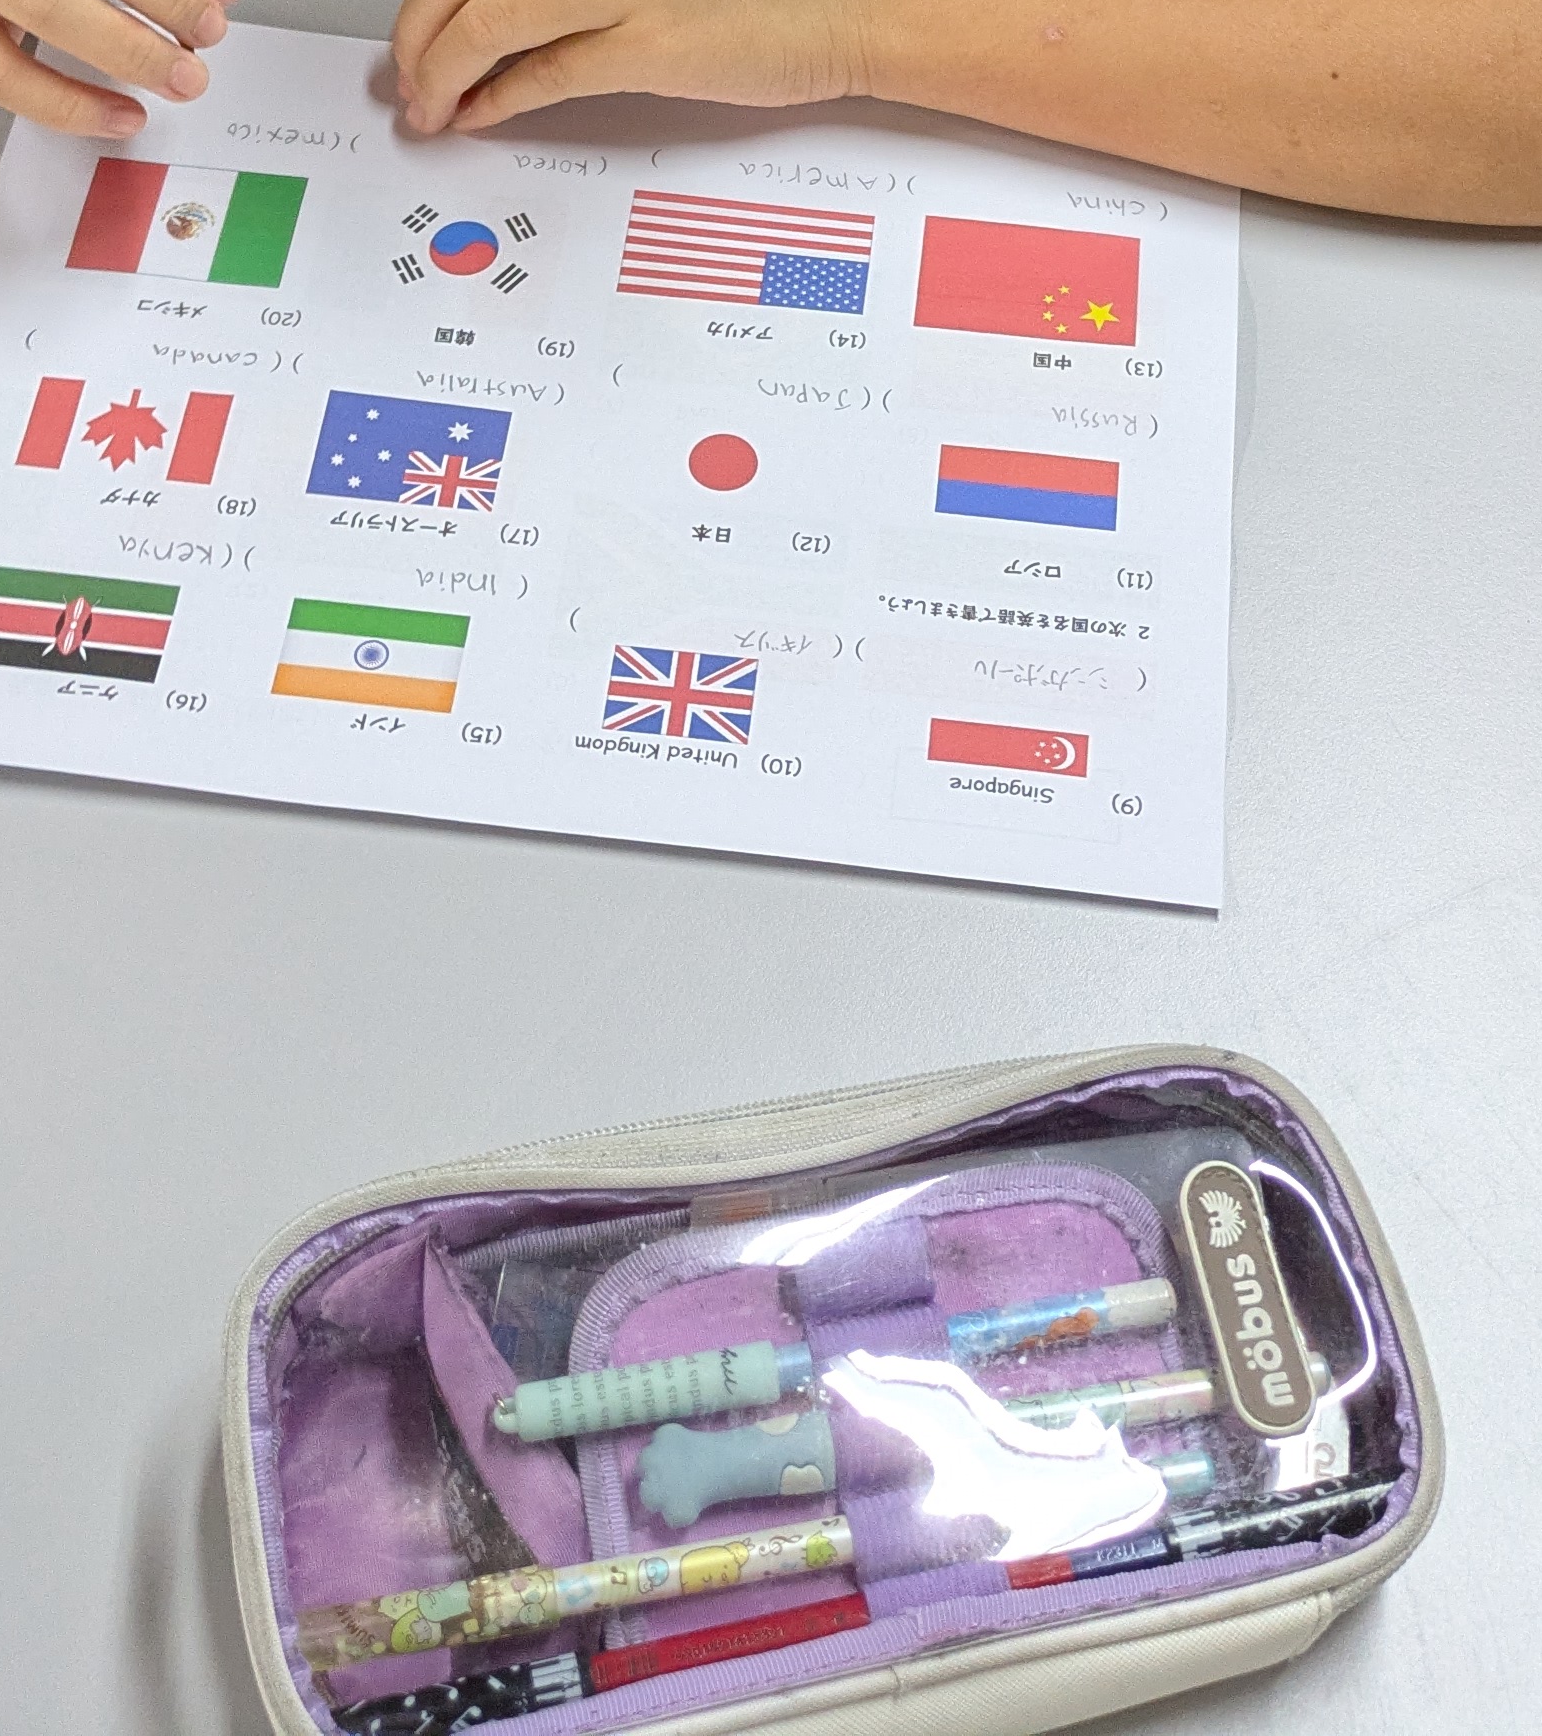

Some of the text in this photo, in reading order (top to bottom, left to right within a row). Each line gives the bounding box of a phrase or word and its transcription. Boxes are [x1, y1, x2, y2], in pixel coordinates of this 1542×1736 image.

[739, 163, 877, 190] America
[137, 300, 301, 327] (20) メキシコ
[435, 327, 574, 358] (19) 韓国
[707, 321, 866, 349] (14) アメリカ
[1033, 352, 1162, 378] (13) 中国
[416, 370, 547, 402] Australia
[1052, 406, 1137, 436] Russia
[100, 488, 256, 516] (18) カナダ
[330, 511, 539, 546] (17) オーストラリア
[692, 524, 830, 554] (12) 日本
[416, 568, 496, 596] India
[1004, 560, 1152, 590] (11) ロシア
[879, 595, 1149, 639] 2 次の国名を英語で書きましょう。
[57, 681, 207, 712] (16) ケニア
[350, 714, 502, 745] (15) インド
[576, 736, 801, 777] (10) United Kingdom
[950, 777, 1142, 816] (9) Singapore
